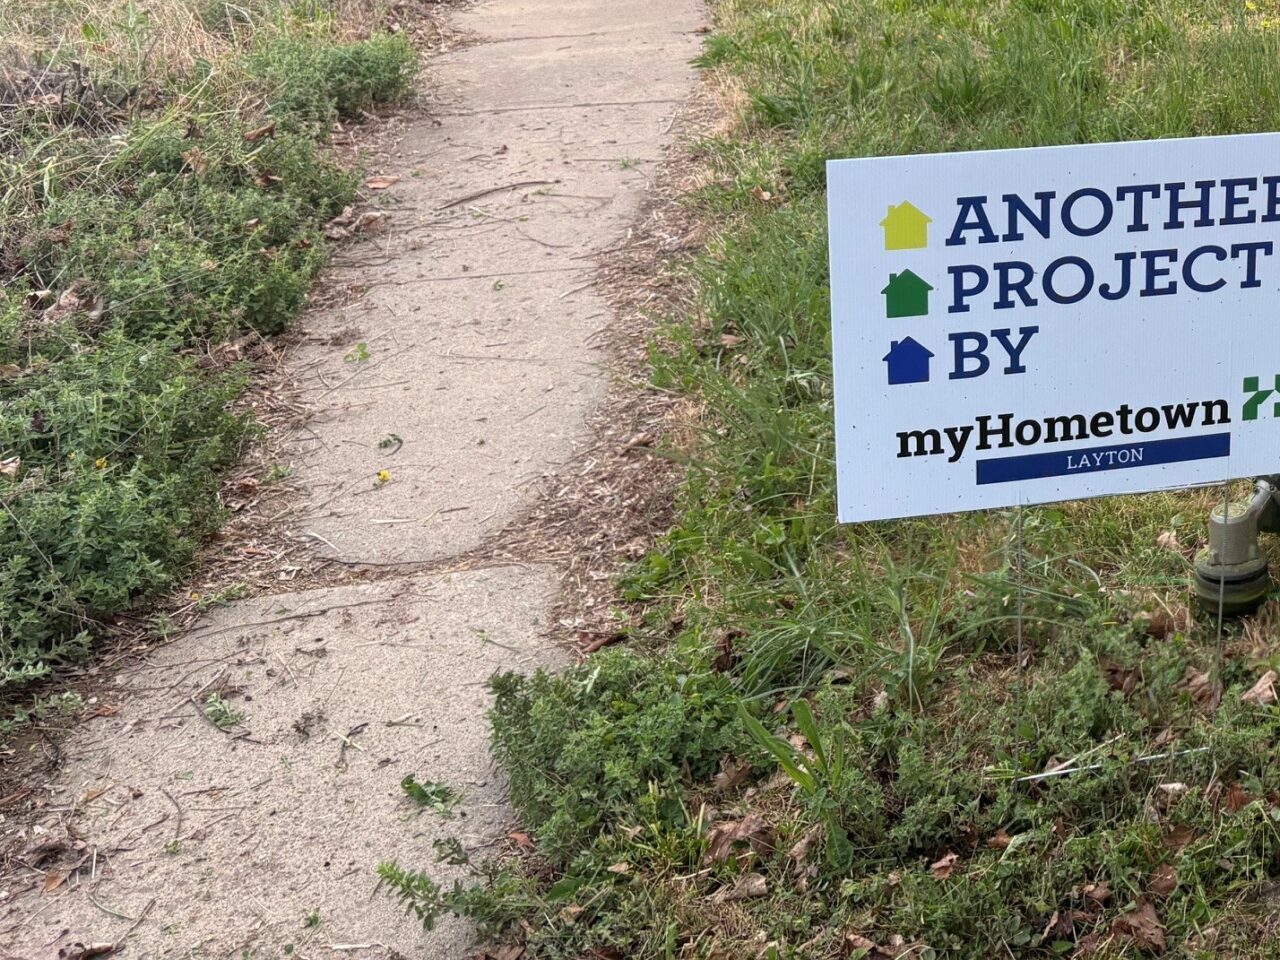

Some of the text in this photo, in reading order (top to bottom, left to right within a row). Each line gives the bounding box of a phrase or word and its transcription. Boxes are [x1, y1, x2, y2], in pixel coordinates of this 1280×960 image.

[947, 241, 1274, 314] PROJECT
[948, 325, 1040, 380] BY
[895, 397, 1232, 463] myHometown
[1066, 447, 1144, 470] LAYTON
